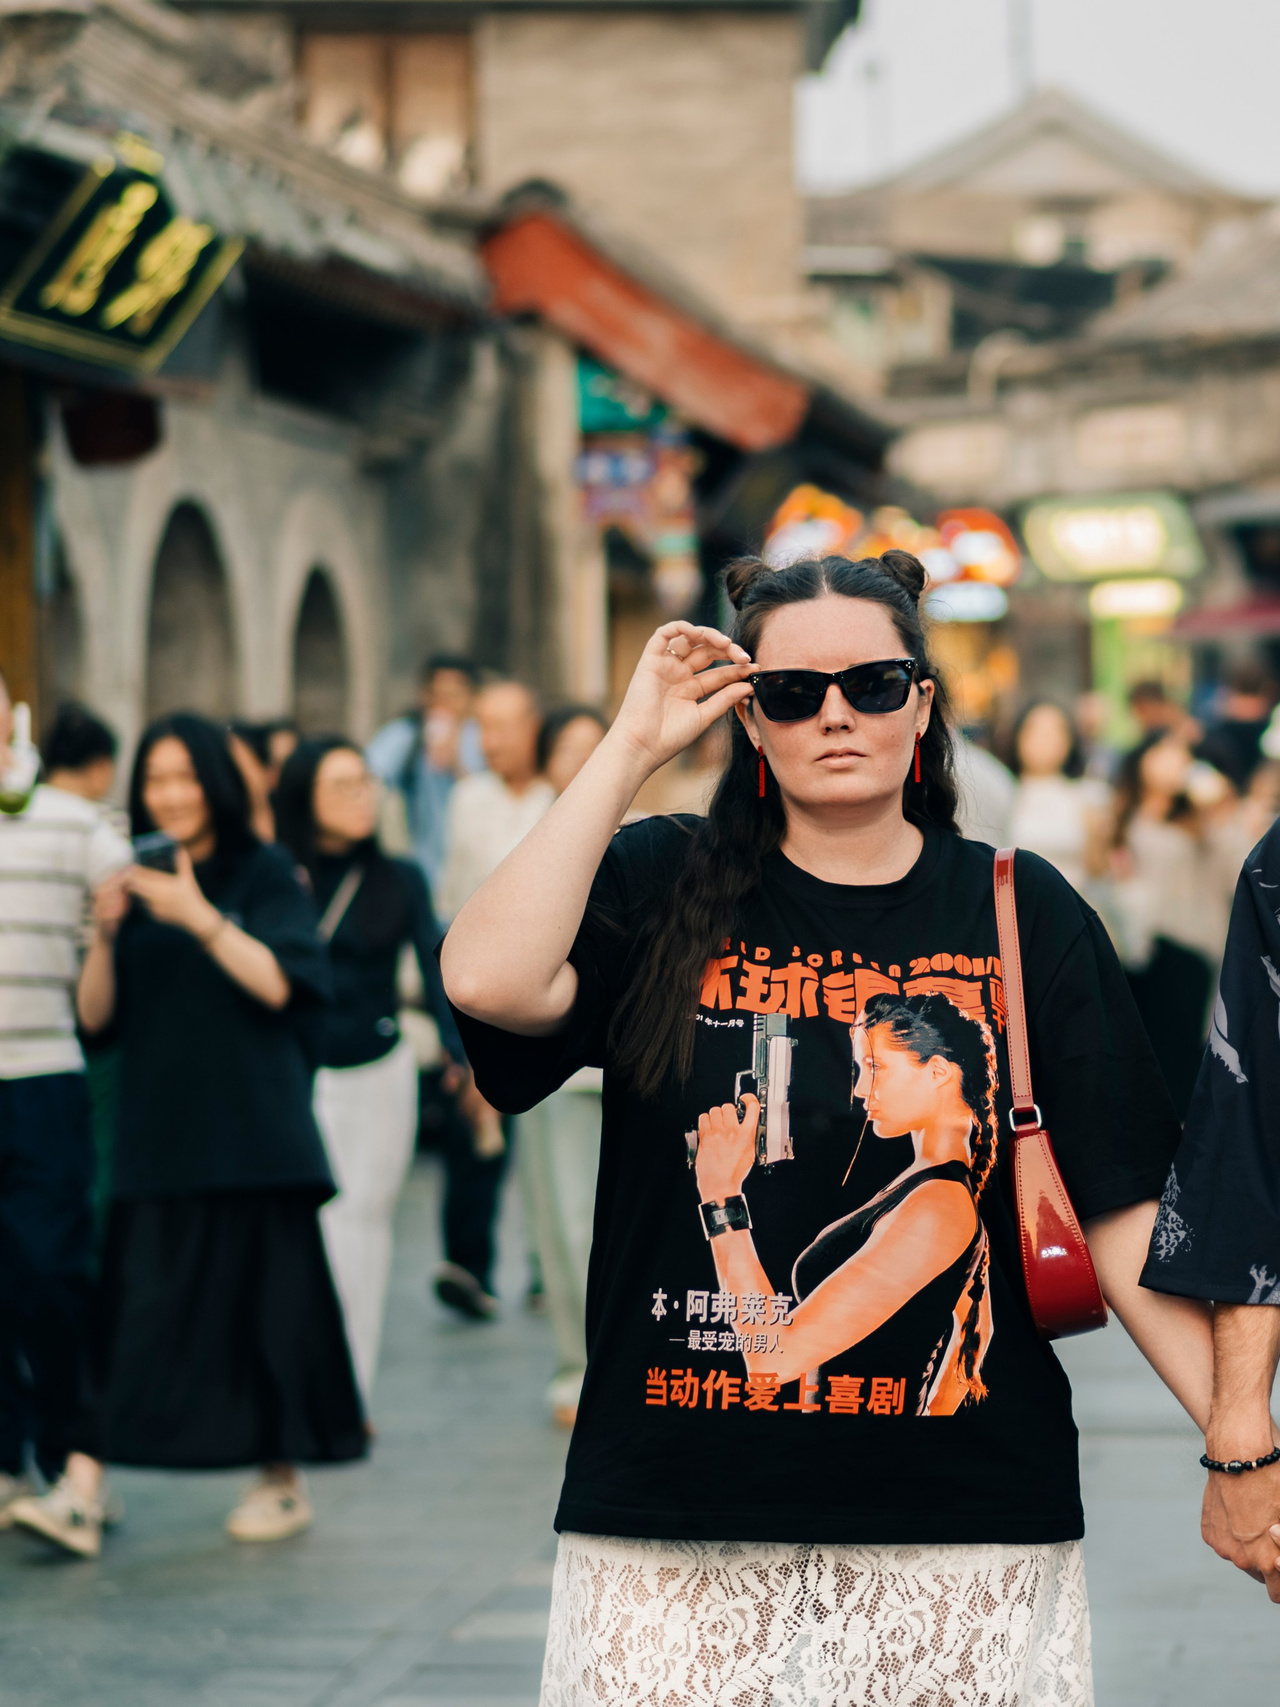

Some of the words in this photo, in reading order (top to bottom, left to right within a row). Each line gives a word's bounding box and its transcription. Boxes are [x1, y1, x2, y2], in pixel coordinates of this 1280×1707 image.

[646, 1367, 906, 1416] 当动作爱上喜剧
